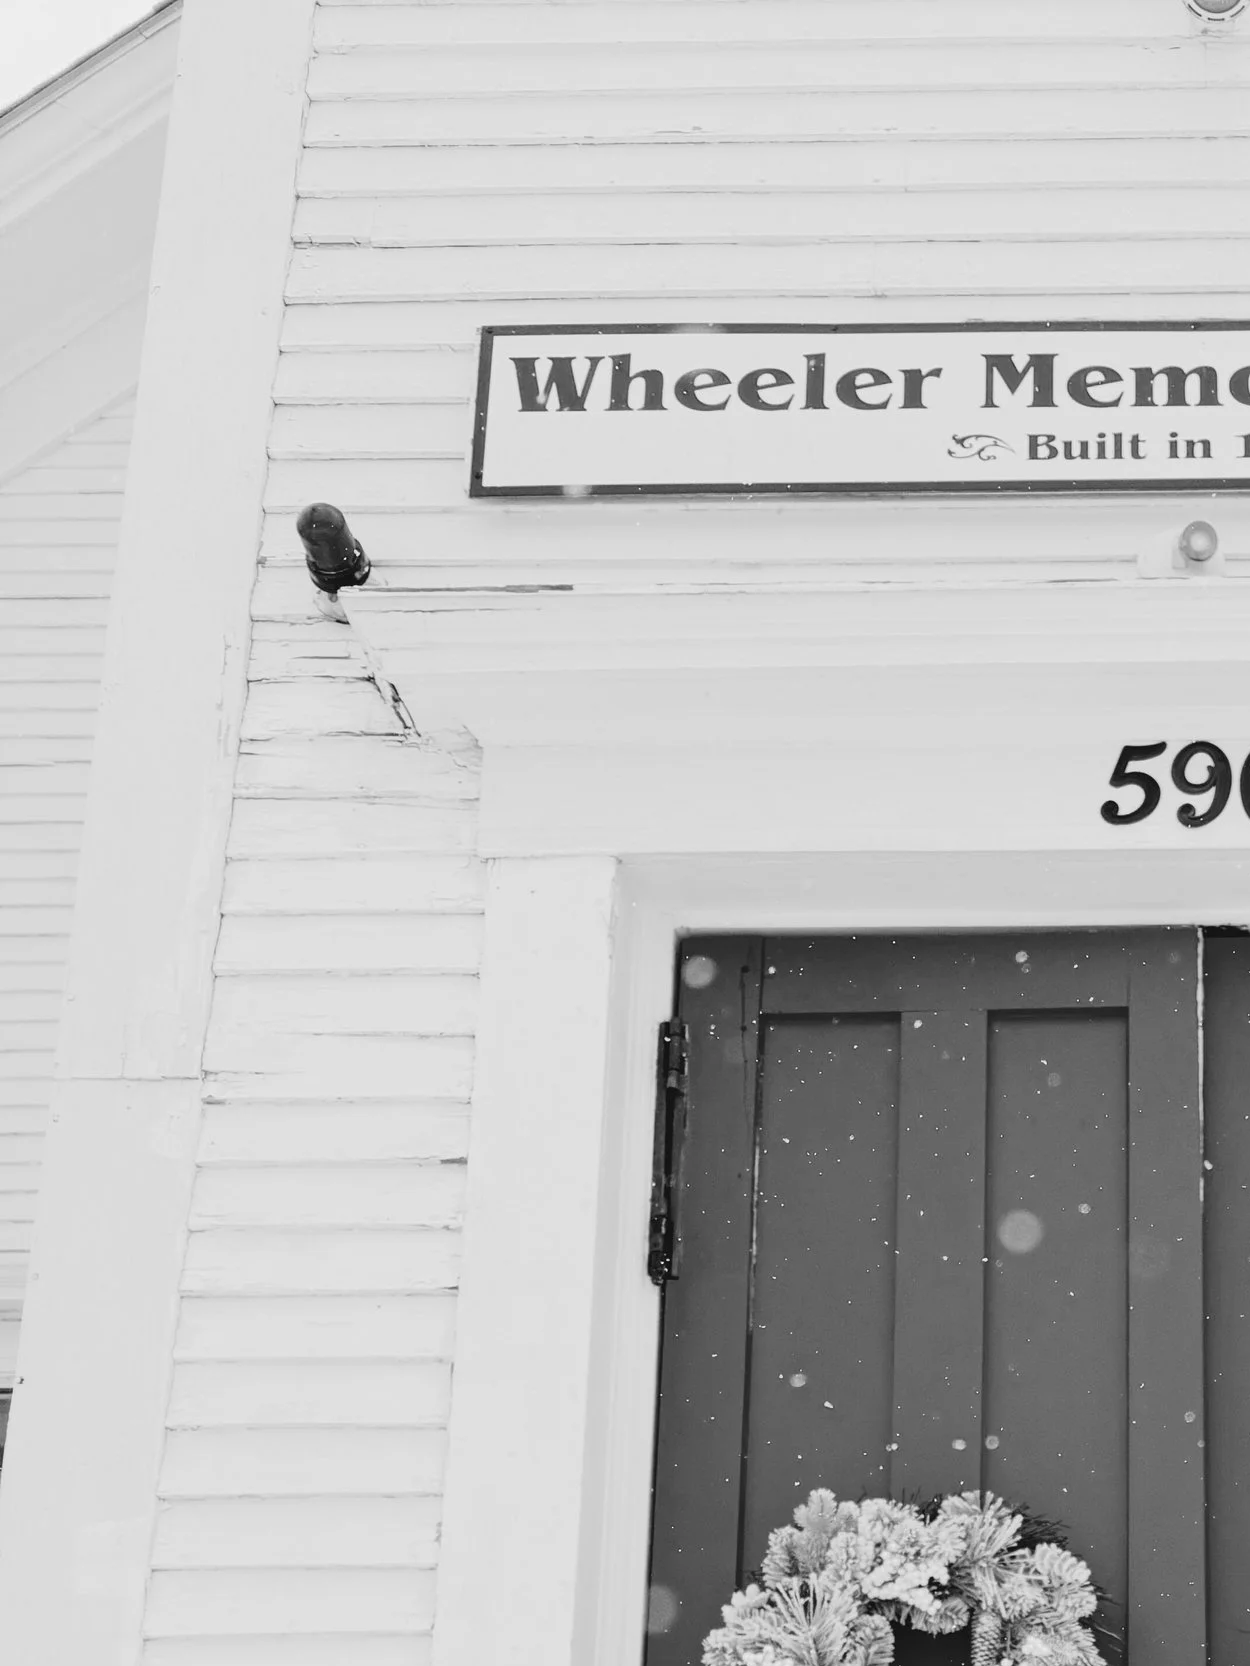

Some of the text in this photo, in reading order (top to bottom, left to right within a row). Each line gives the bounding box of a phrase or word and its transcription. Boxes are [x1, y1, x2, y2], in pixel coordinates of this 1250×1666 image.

[508, 352, 943, 413] Wheeler
[1027, 432, 1147, 461] Built
[1168, 431, 1213, 460] in
